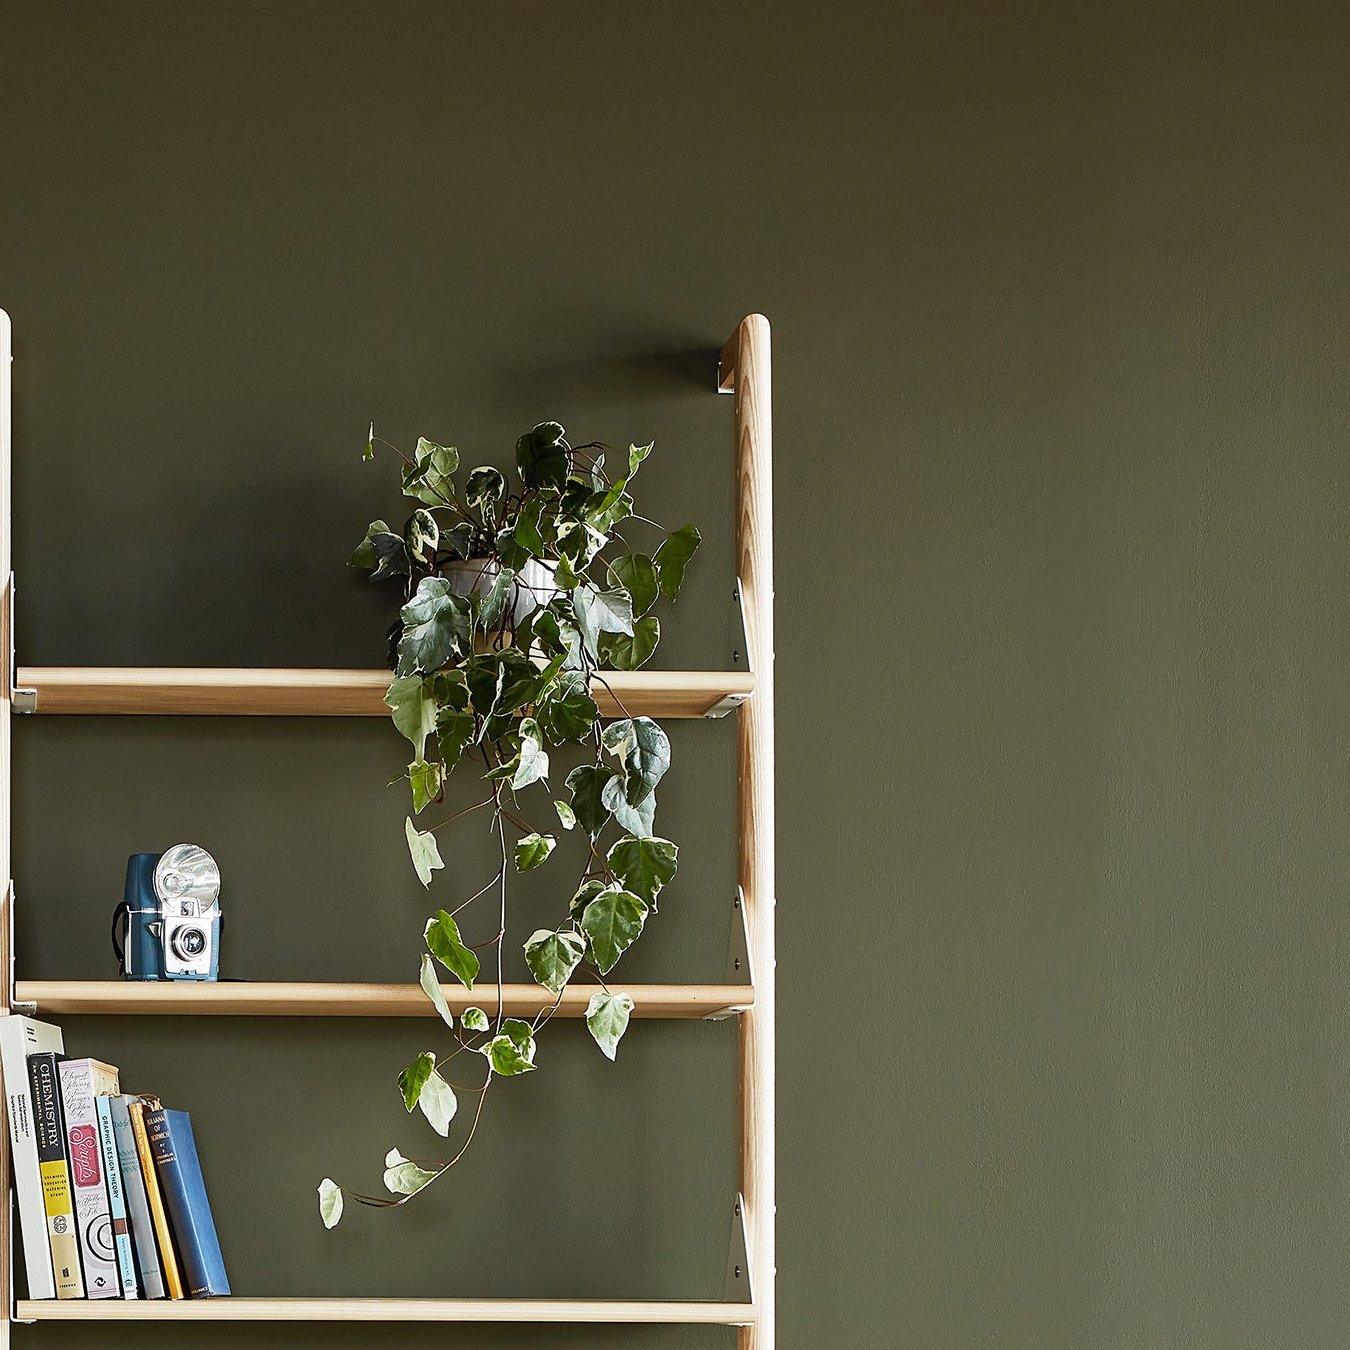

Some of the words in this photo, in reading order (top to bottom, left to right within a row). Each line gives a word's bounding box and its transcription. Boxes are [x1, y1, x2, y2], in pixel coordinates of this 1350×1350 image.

[34, 1075, 42, 1120] EXPERIMENTAL
[40, 1063, 59, 1148] CHEMISTRY
[102, 1116, 111, 1144] GRAPHIC
[69, 1128, 96, 1183] Scripts
[106, 1146, 115, 1171] DESIGN
[110, 1173, 119, 1198] THEORY
